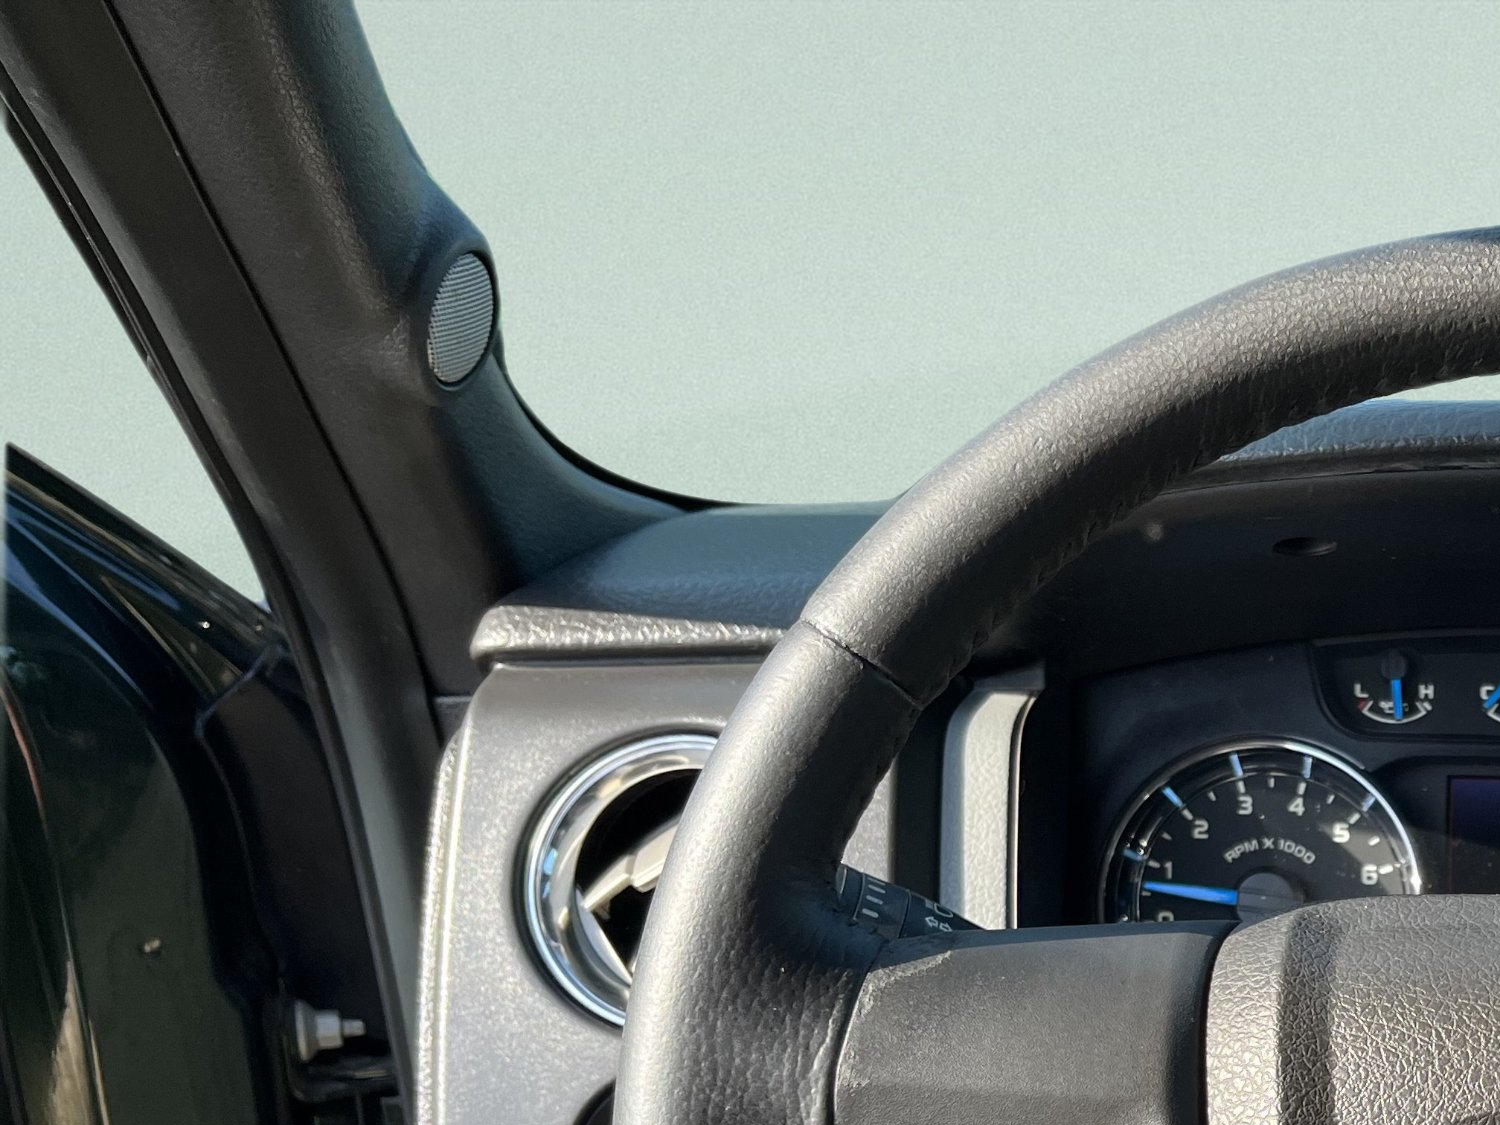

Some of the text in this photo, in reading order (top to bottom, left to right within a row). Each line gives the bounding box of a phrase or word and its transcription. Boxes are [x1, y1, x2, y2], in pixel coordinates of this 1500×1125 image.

[1354, 683, 1369, 698] L
[1418, 684, 1435, 700] H
[1237, 796, 1253, 815] 3
[1287, 796, 1305, 816] 4
[1192, 820, 1209, 839] 2
[1332, 822, 1350, 843] 5
[1223, 838, 1259, 863] RPM
[1278, 838, 1316, 865] 1000
[1164, 861, 1173, 880] 1
[1360, 865, 1378, 885] 6
